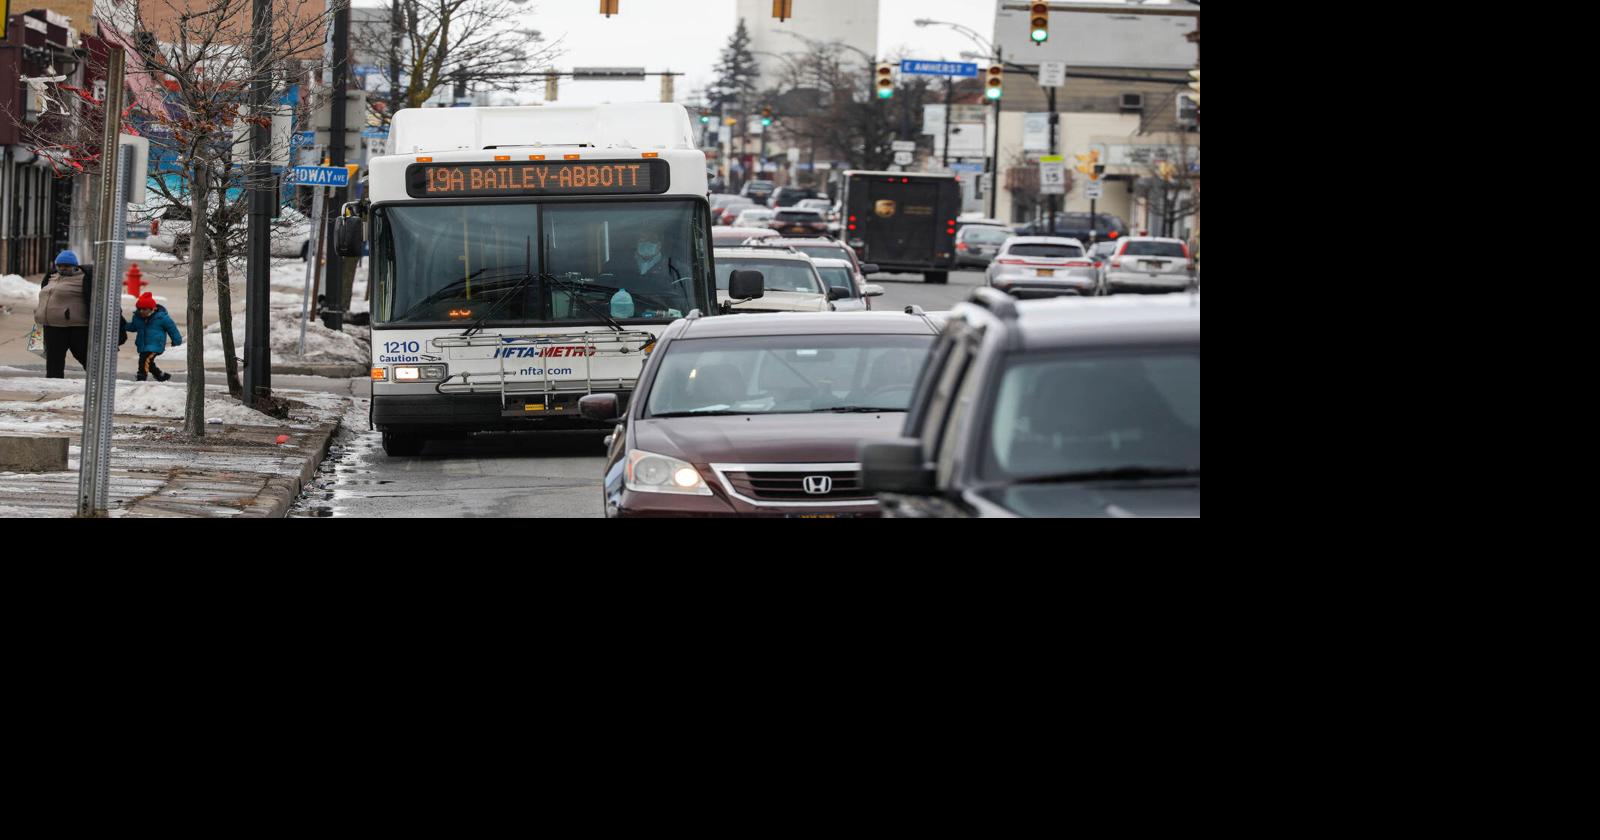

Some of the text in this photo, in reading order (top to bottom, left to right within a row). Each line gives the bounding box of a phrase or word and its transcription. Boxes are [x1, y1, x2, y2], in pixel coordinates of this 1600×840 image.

[903, 61, 911, 71] E
[913, 62, 962, 73] AMHERST
[286, 168, 346, 183] IDWAY AVE
[426, 165, 640, 192] 19A BAILEY-ABBOTT
[383, 340, 420, 354] 1210
[493, 346, 597, 359] NFTA-METRO
[379, 354, 419, 363] Caution
[520, 366, 572, 376] nftacom
